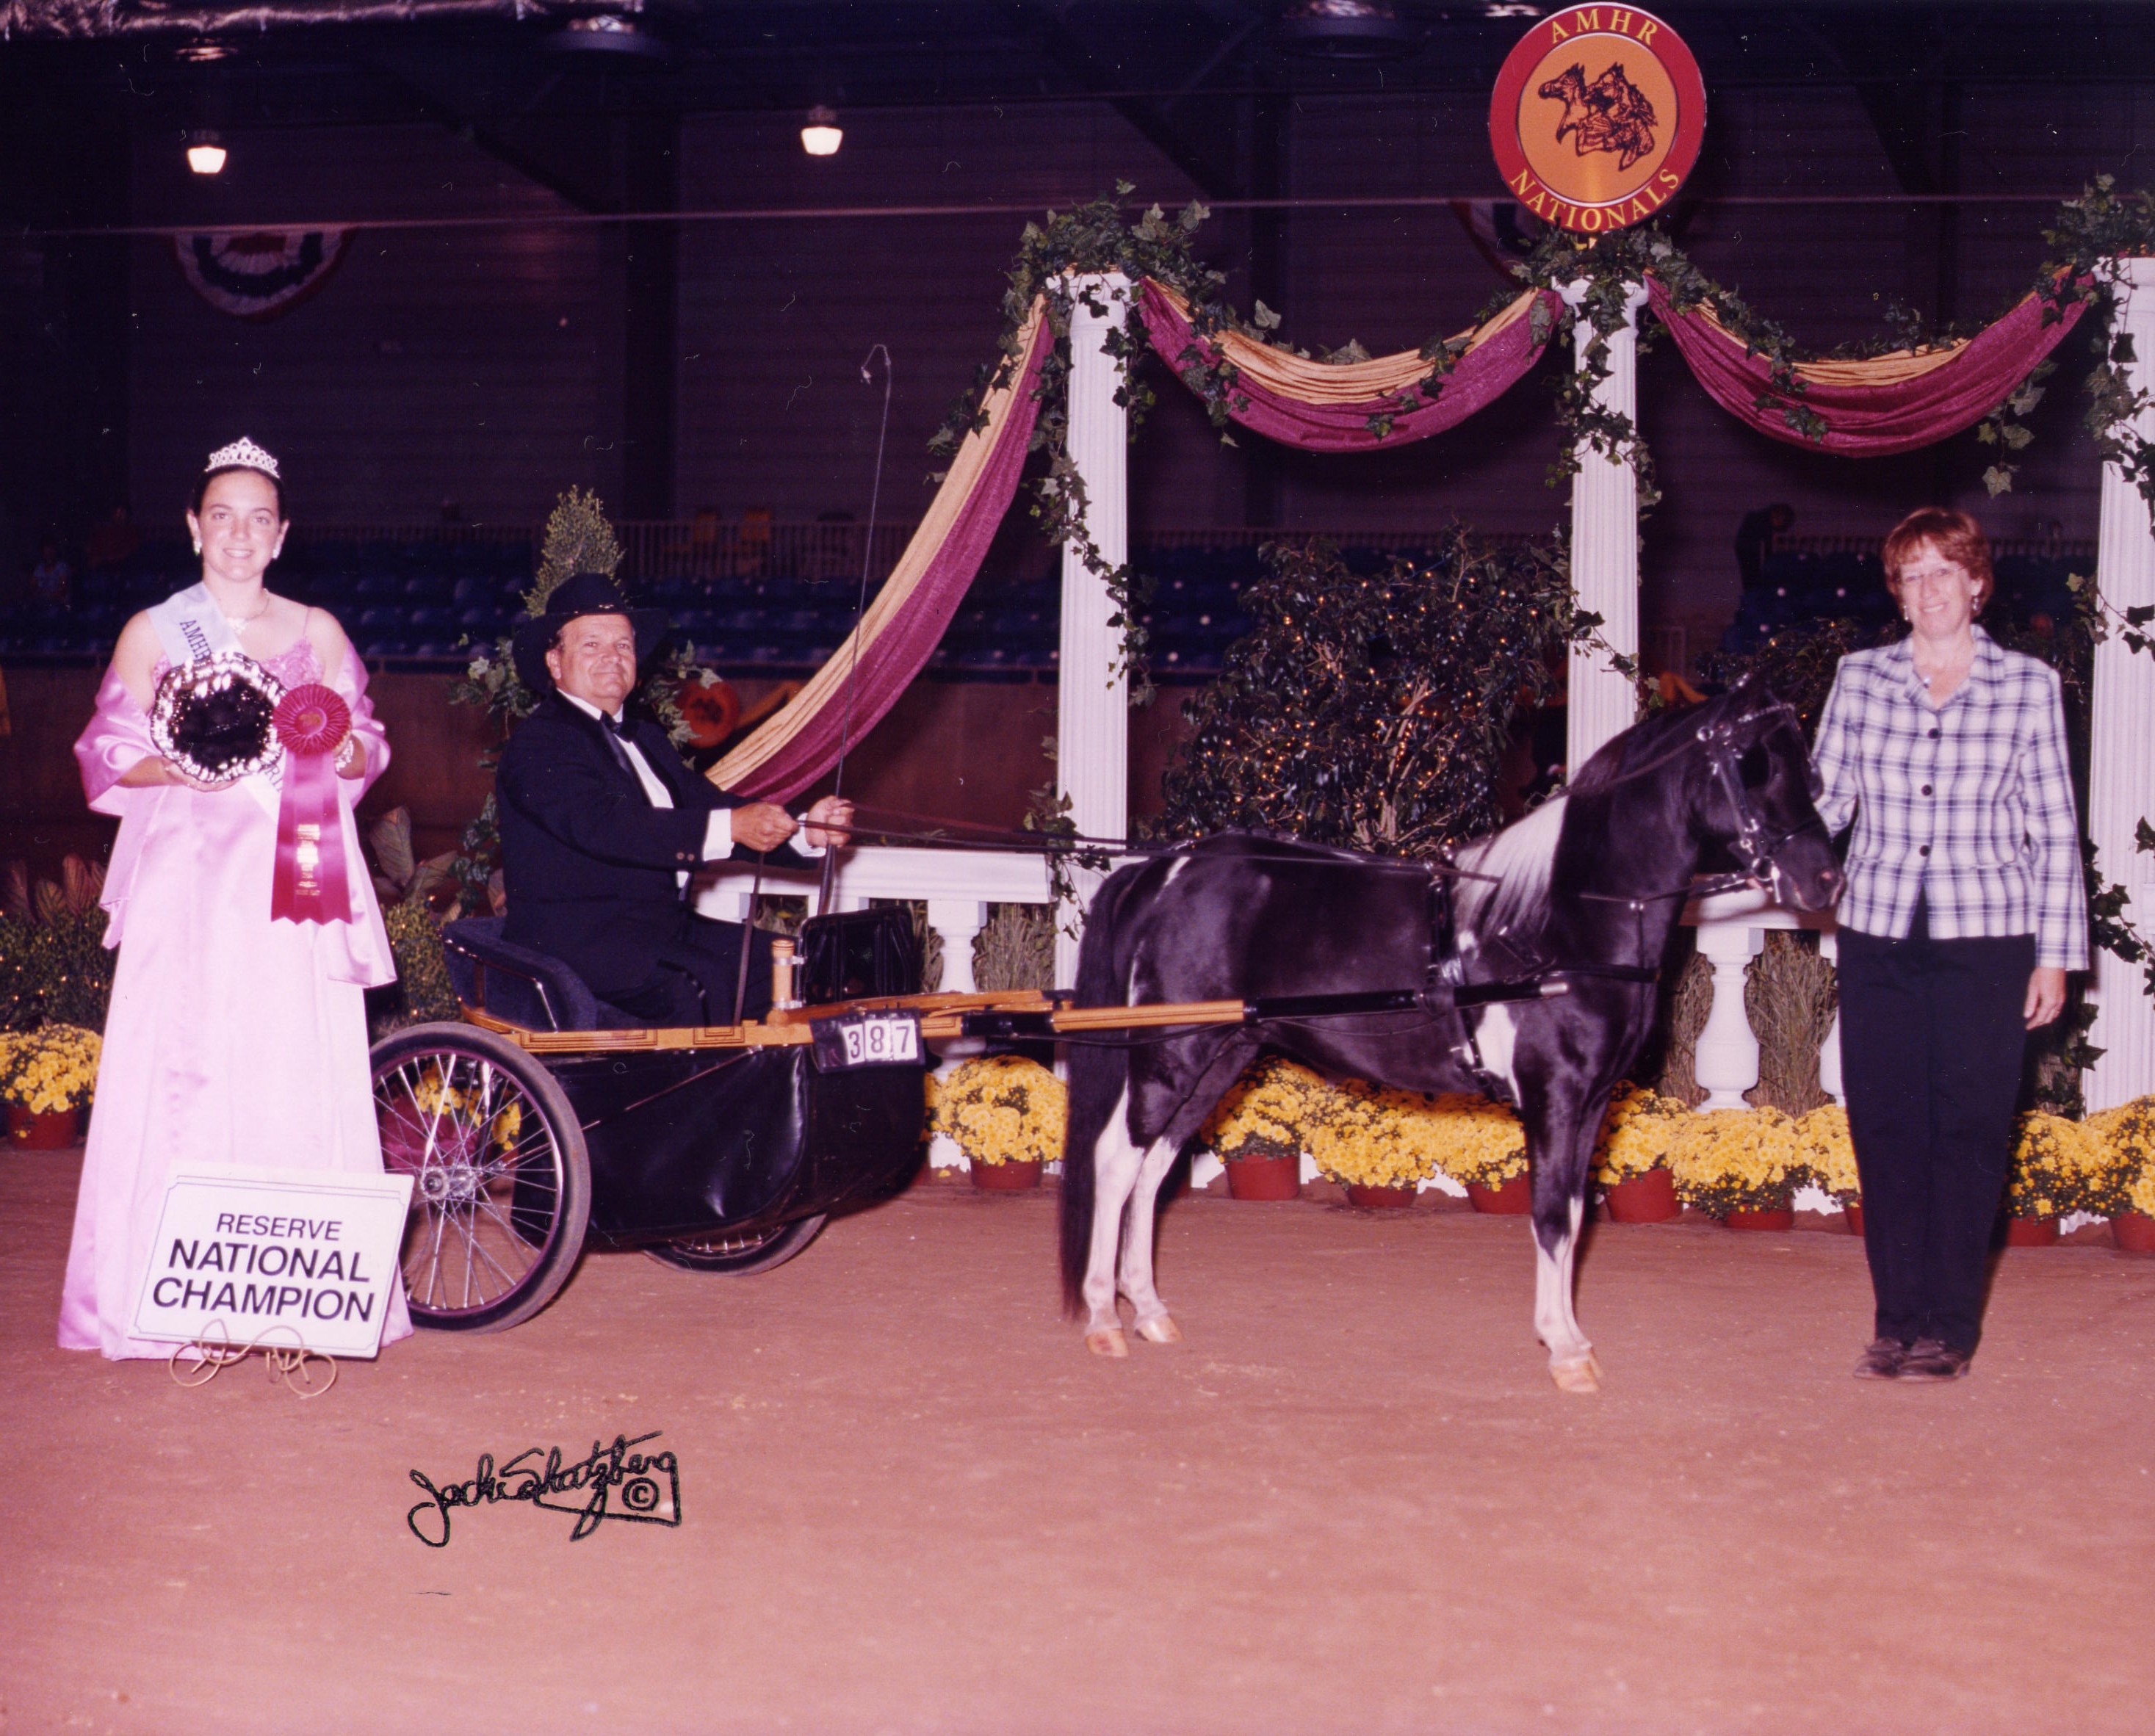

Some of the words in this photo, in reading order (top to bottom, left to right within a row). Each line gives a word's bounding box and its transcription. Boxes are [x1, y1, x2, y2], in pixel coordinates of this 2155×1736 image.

[1551, 8, 1658, 45] AMHR
[1509, 168, 1679, 231] NATIONALS
[179, 620, 212, 664] AMHR
[848, 1025, 911, 1059] 387
[216, 1213, 342, 1241] RESERVE
[168, 1239, 370, 1283] NATIONAL
[153, 1276, 375, 1323] CHAMPION
